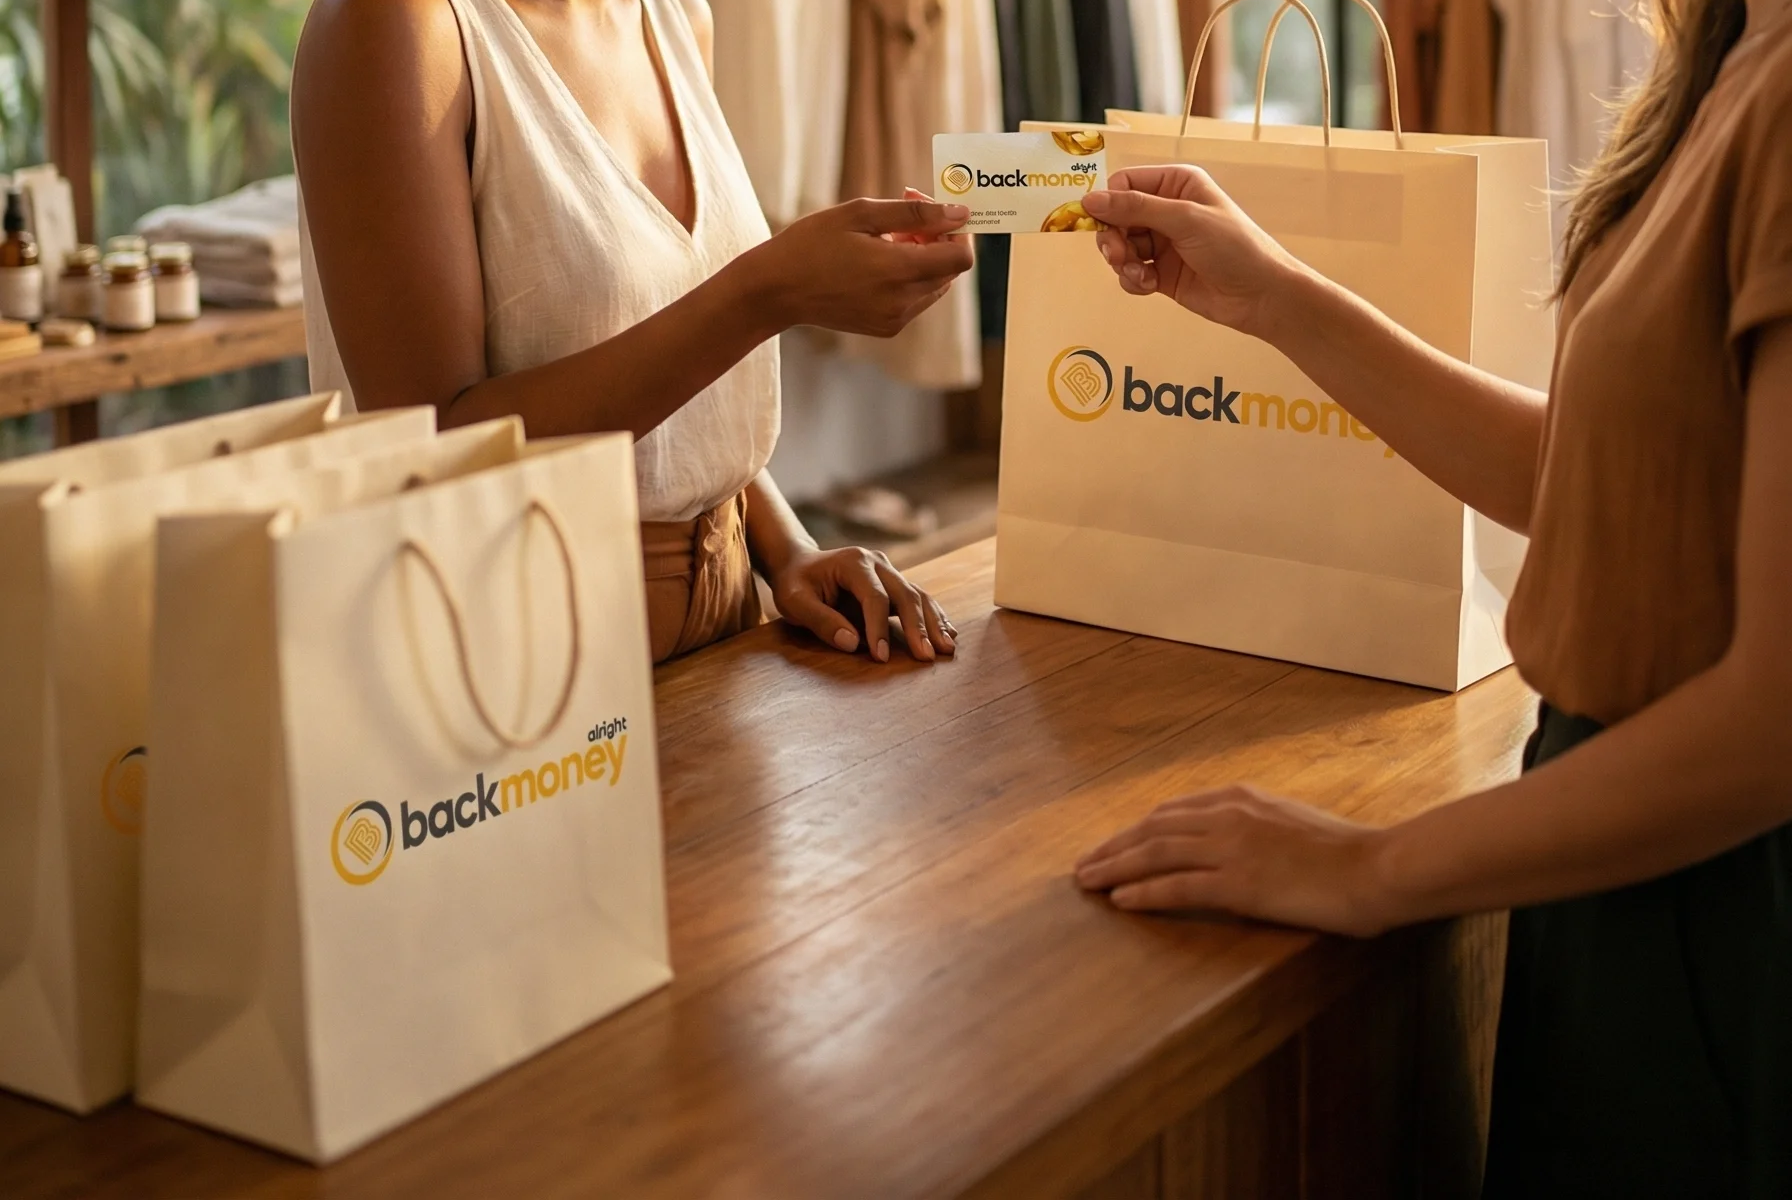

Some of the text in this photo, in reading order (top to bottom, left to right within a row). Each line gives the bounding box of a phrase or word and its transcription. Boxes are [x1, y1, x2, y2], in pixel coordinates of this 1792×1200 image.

[976, 169, 1096, 192] backmoney
[1122, 365, 1396, 459] backmon
[587, 716, 628, 742] alright
[400, 734, 627, 850] backmoney
